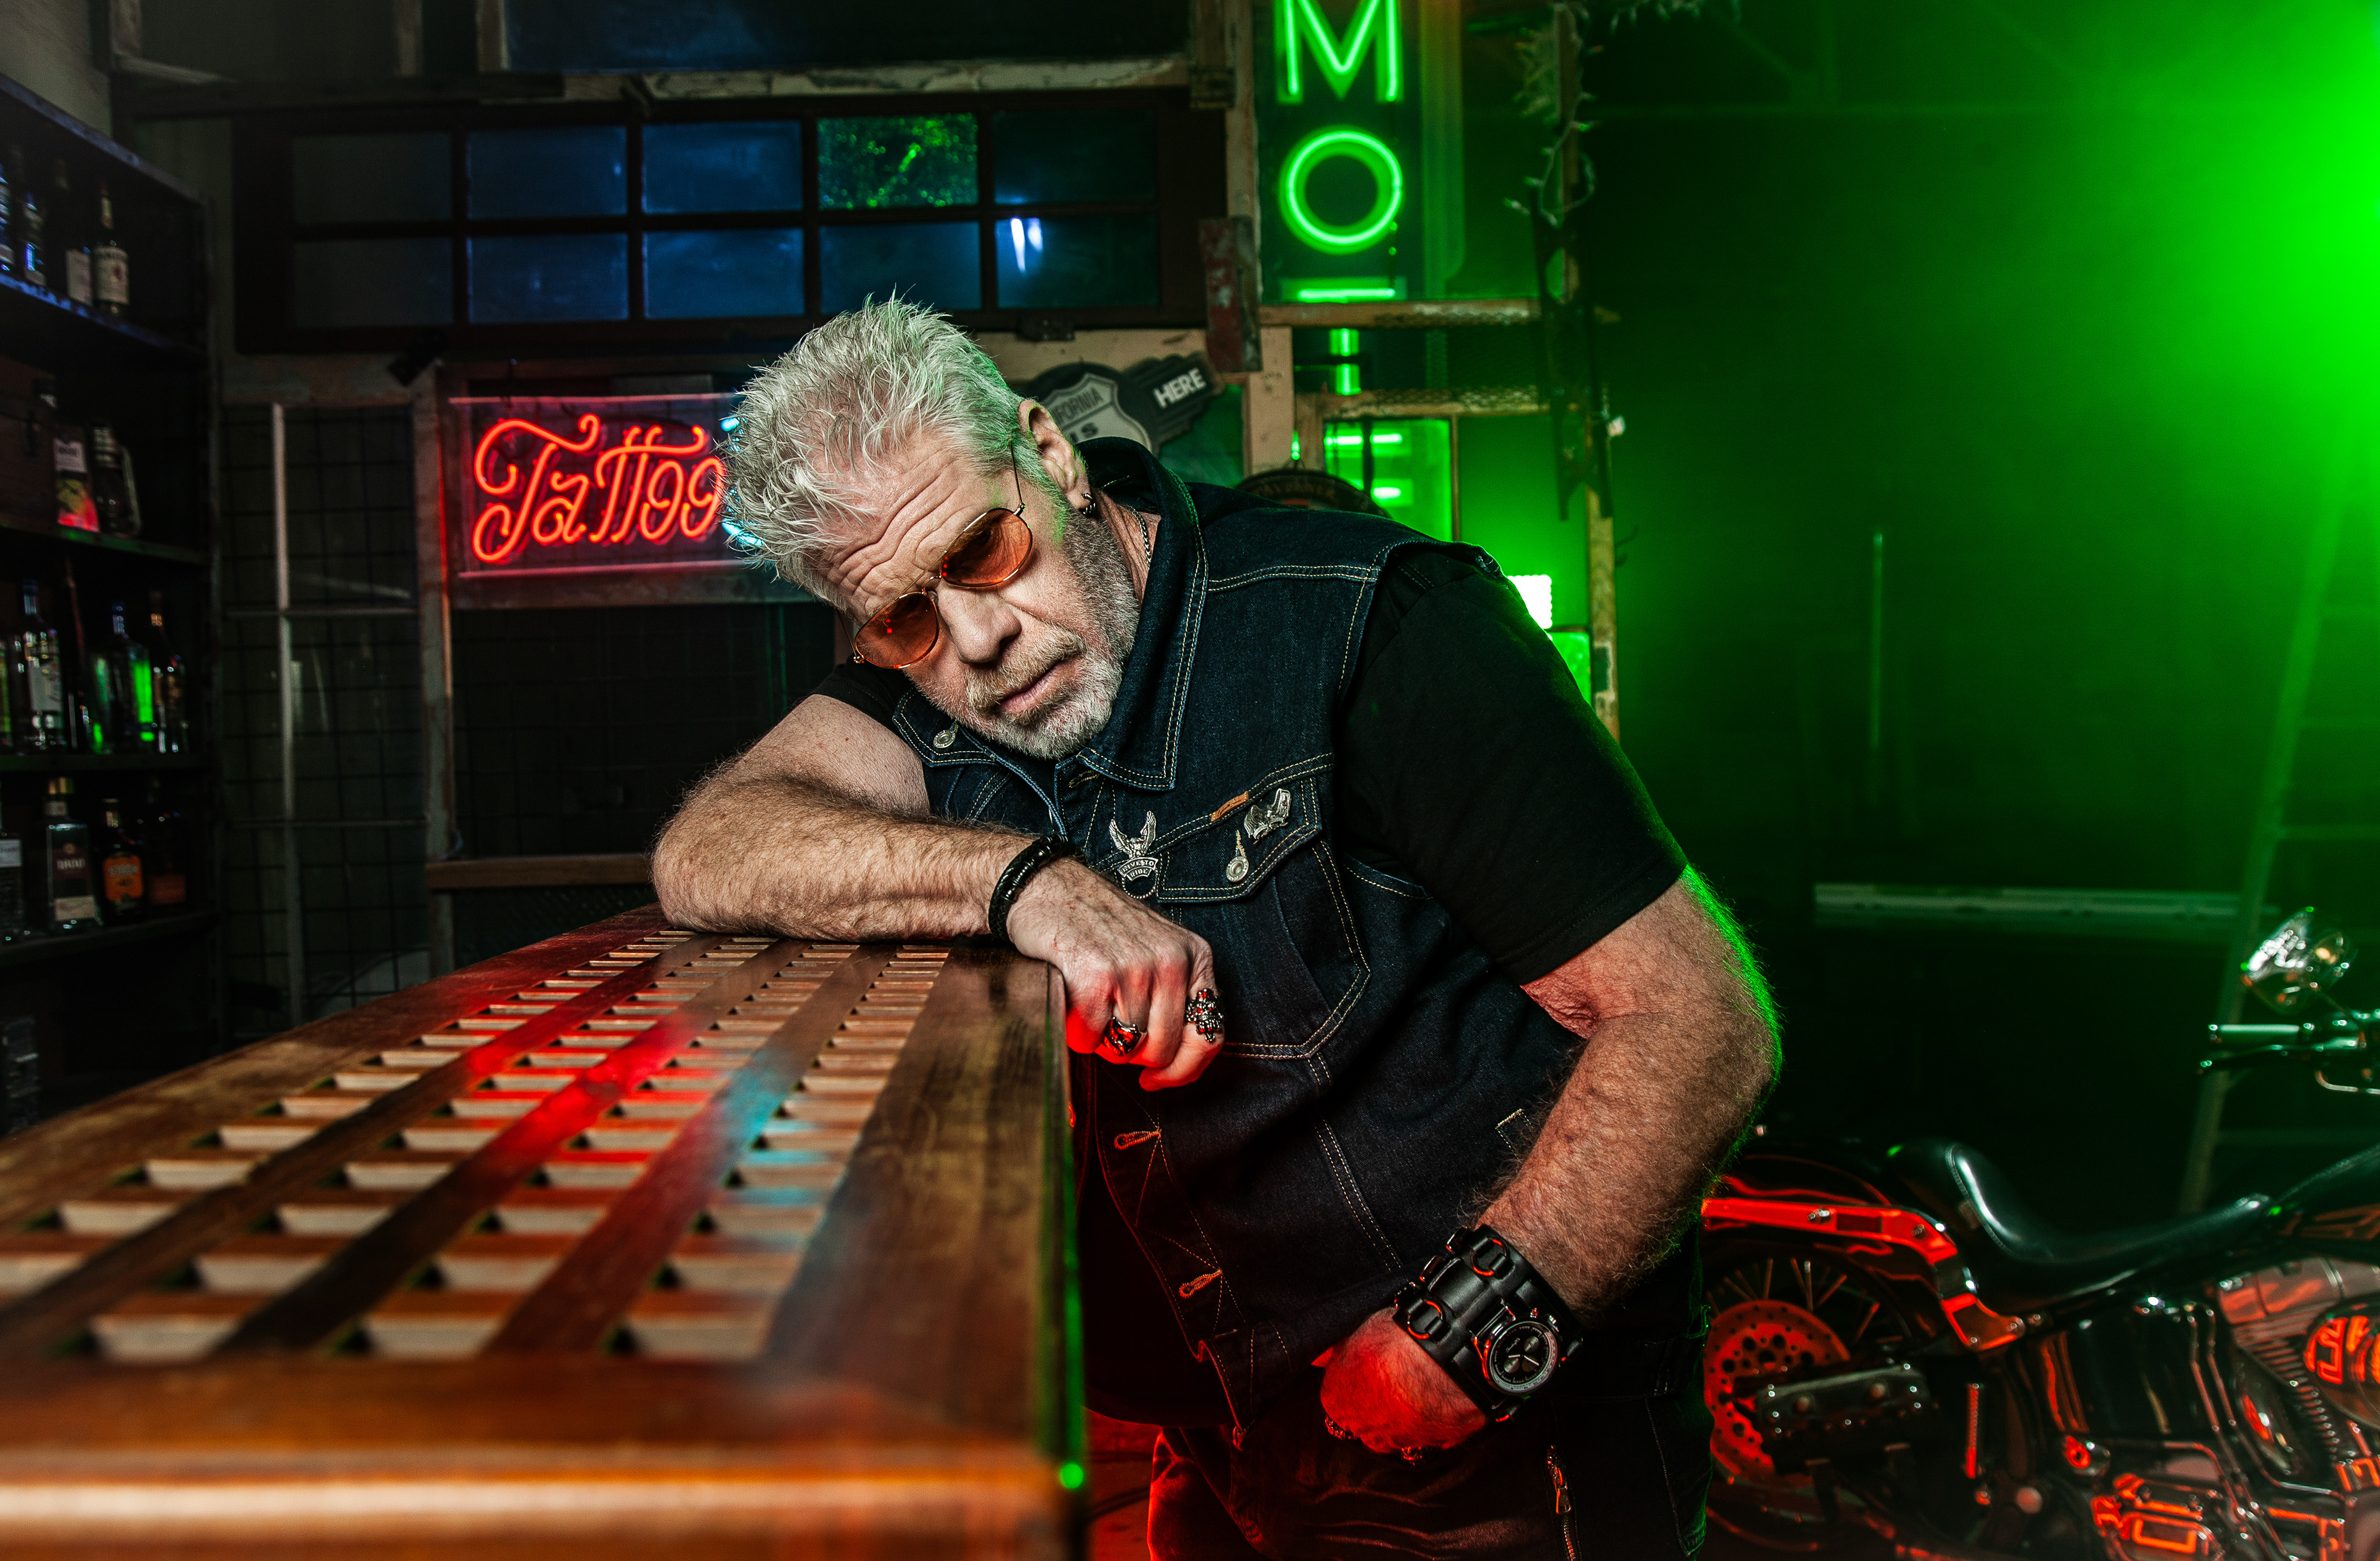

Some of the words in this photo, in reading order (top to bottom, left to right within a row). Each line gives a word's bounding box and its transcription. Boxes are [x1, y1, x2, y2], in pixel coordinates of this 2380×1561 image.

[1153, 367, 1206, 409] HERE
[1053, 385, 1104, 426] IFORNIA
[1122, 860, 1140, 873] LIVE
[1130, 868, 1148, 877] RIDE
